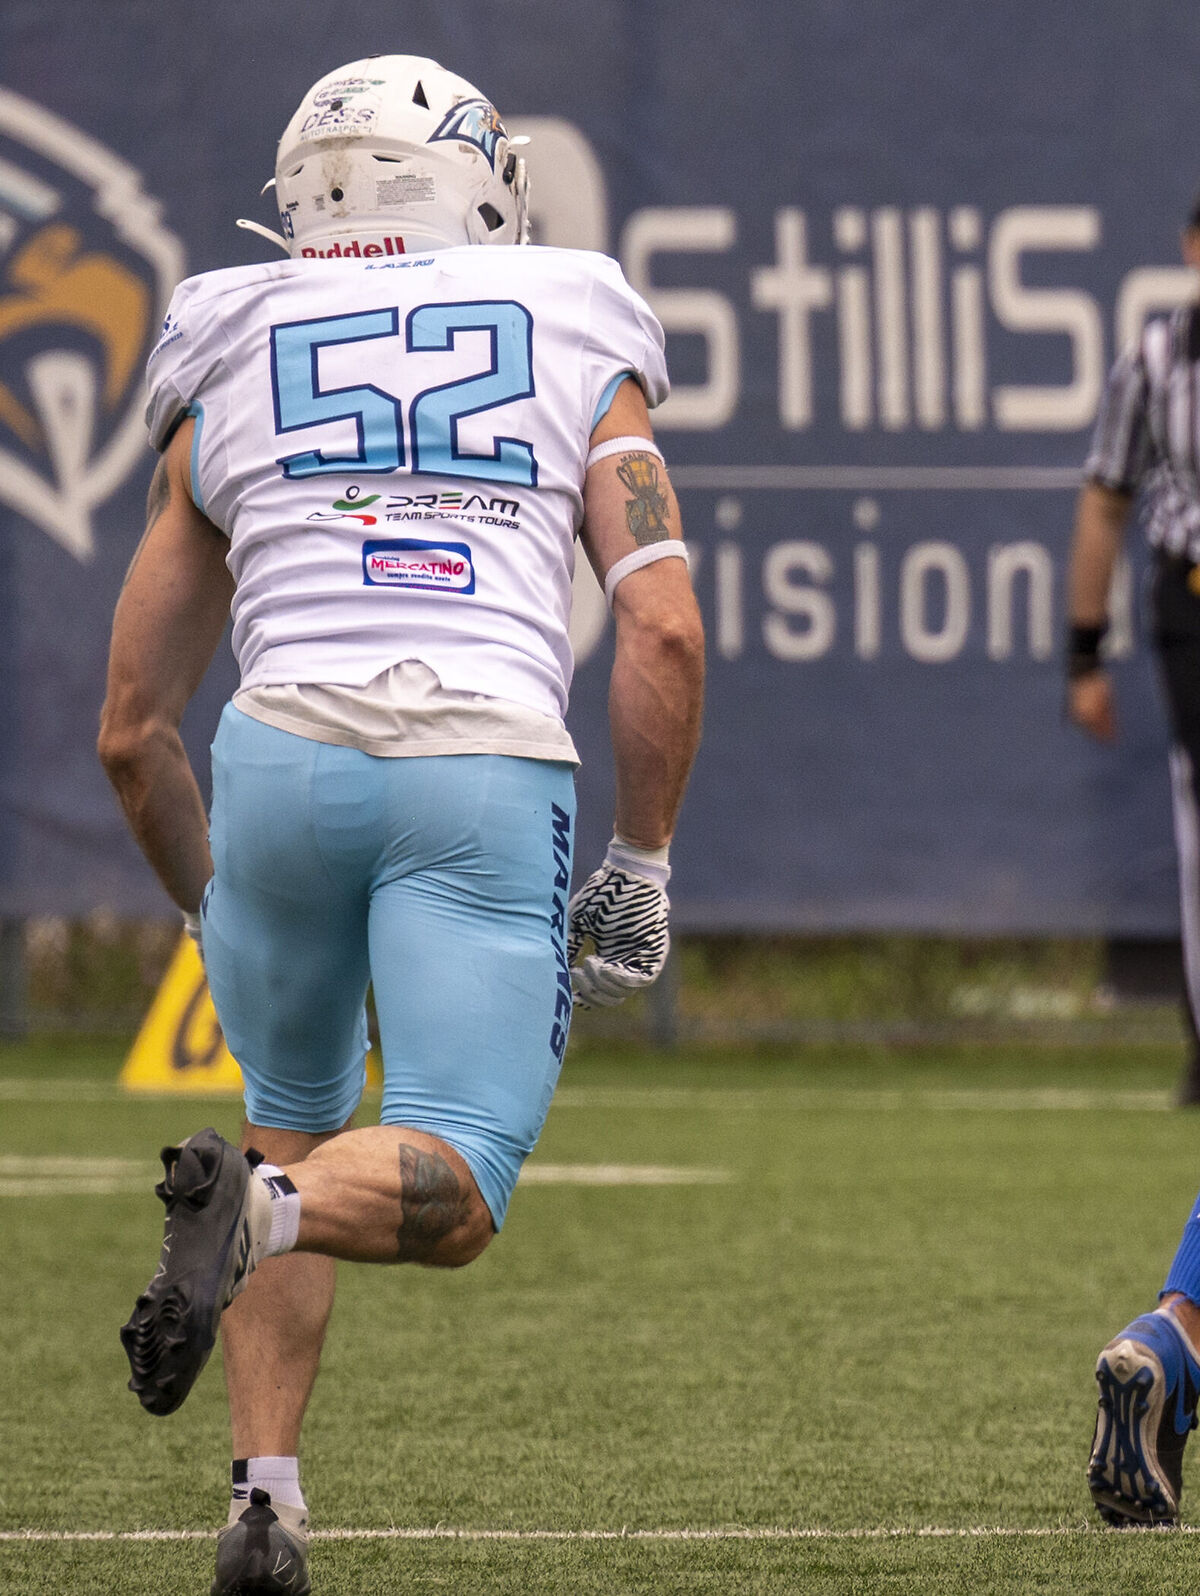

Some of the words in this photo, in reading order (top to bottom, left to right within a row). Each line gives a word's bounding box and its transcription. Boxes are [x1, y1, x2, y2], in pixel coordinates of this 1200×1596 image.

[270, 300, 540, 488] 52
[386, 492, 521, 518] DREAM
[385, 511, 423, 522] TEAM
[423, 511, 475, 523] SPORTS
[477, 515, 521, 530] TOURS
[371, 558, 465, 576] MERCATINO
[550, 801, 572, 1065] MARINES
